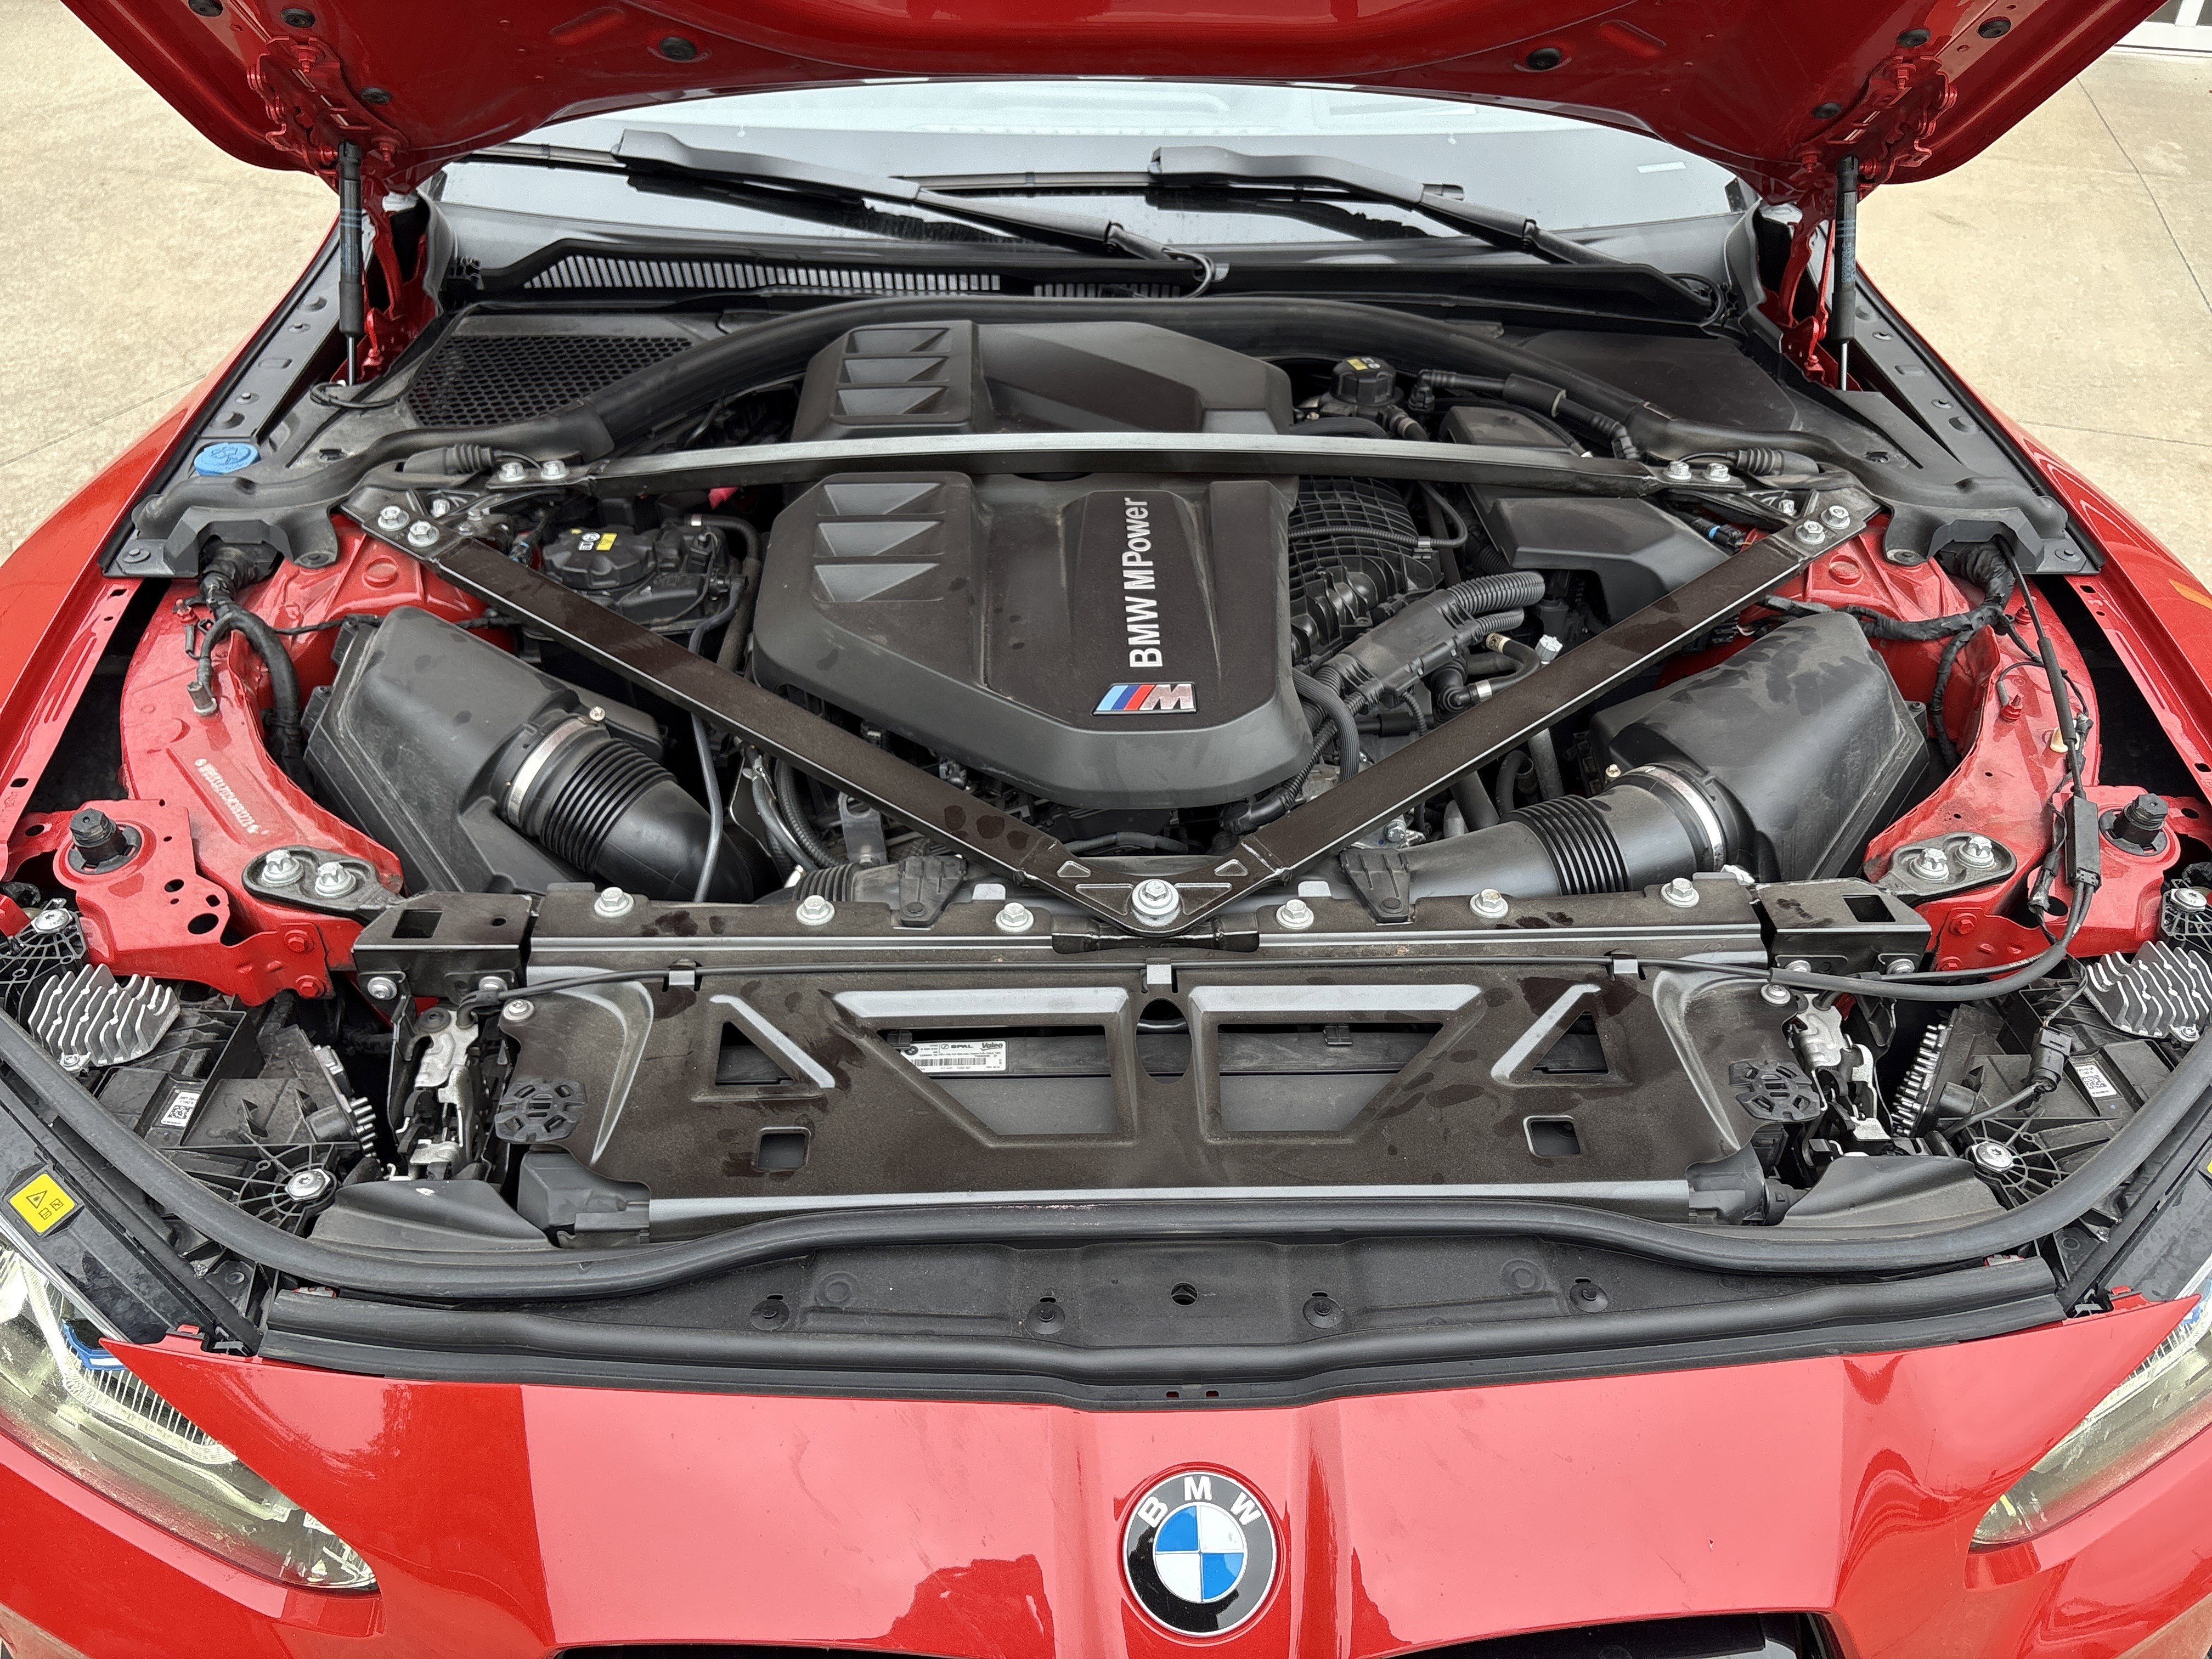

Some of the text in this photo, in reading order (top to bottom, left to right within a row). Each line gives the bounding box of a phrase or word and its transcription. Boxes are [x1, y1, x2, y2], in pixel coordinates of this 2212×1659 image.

[1125, 596, 1163, 667] BMW
[1139, 684, 1194, 710] M
[1138, 1476, 1261, 1528] BMW
